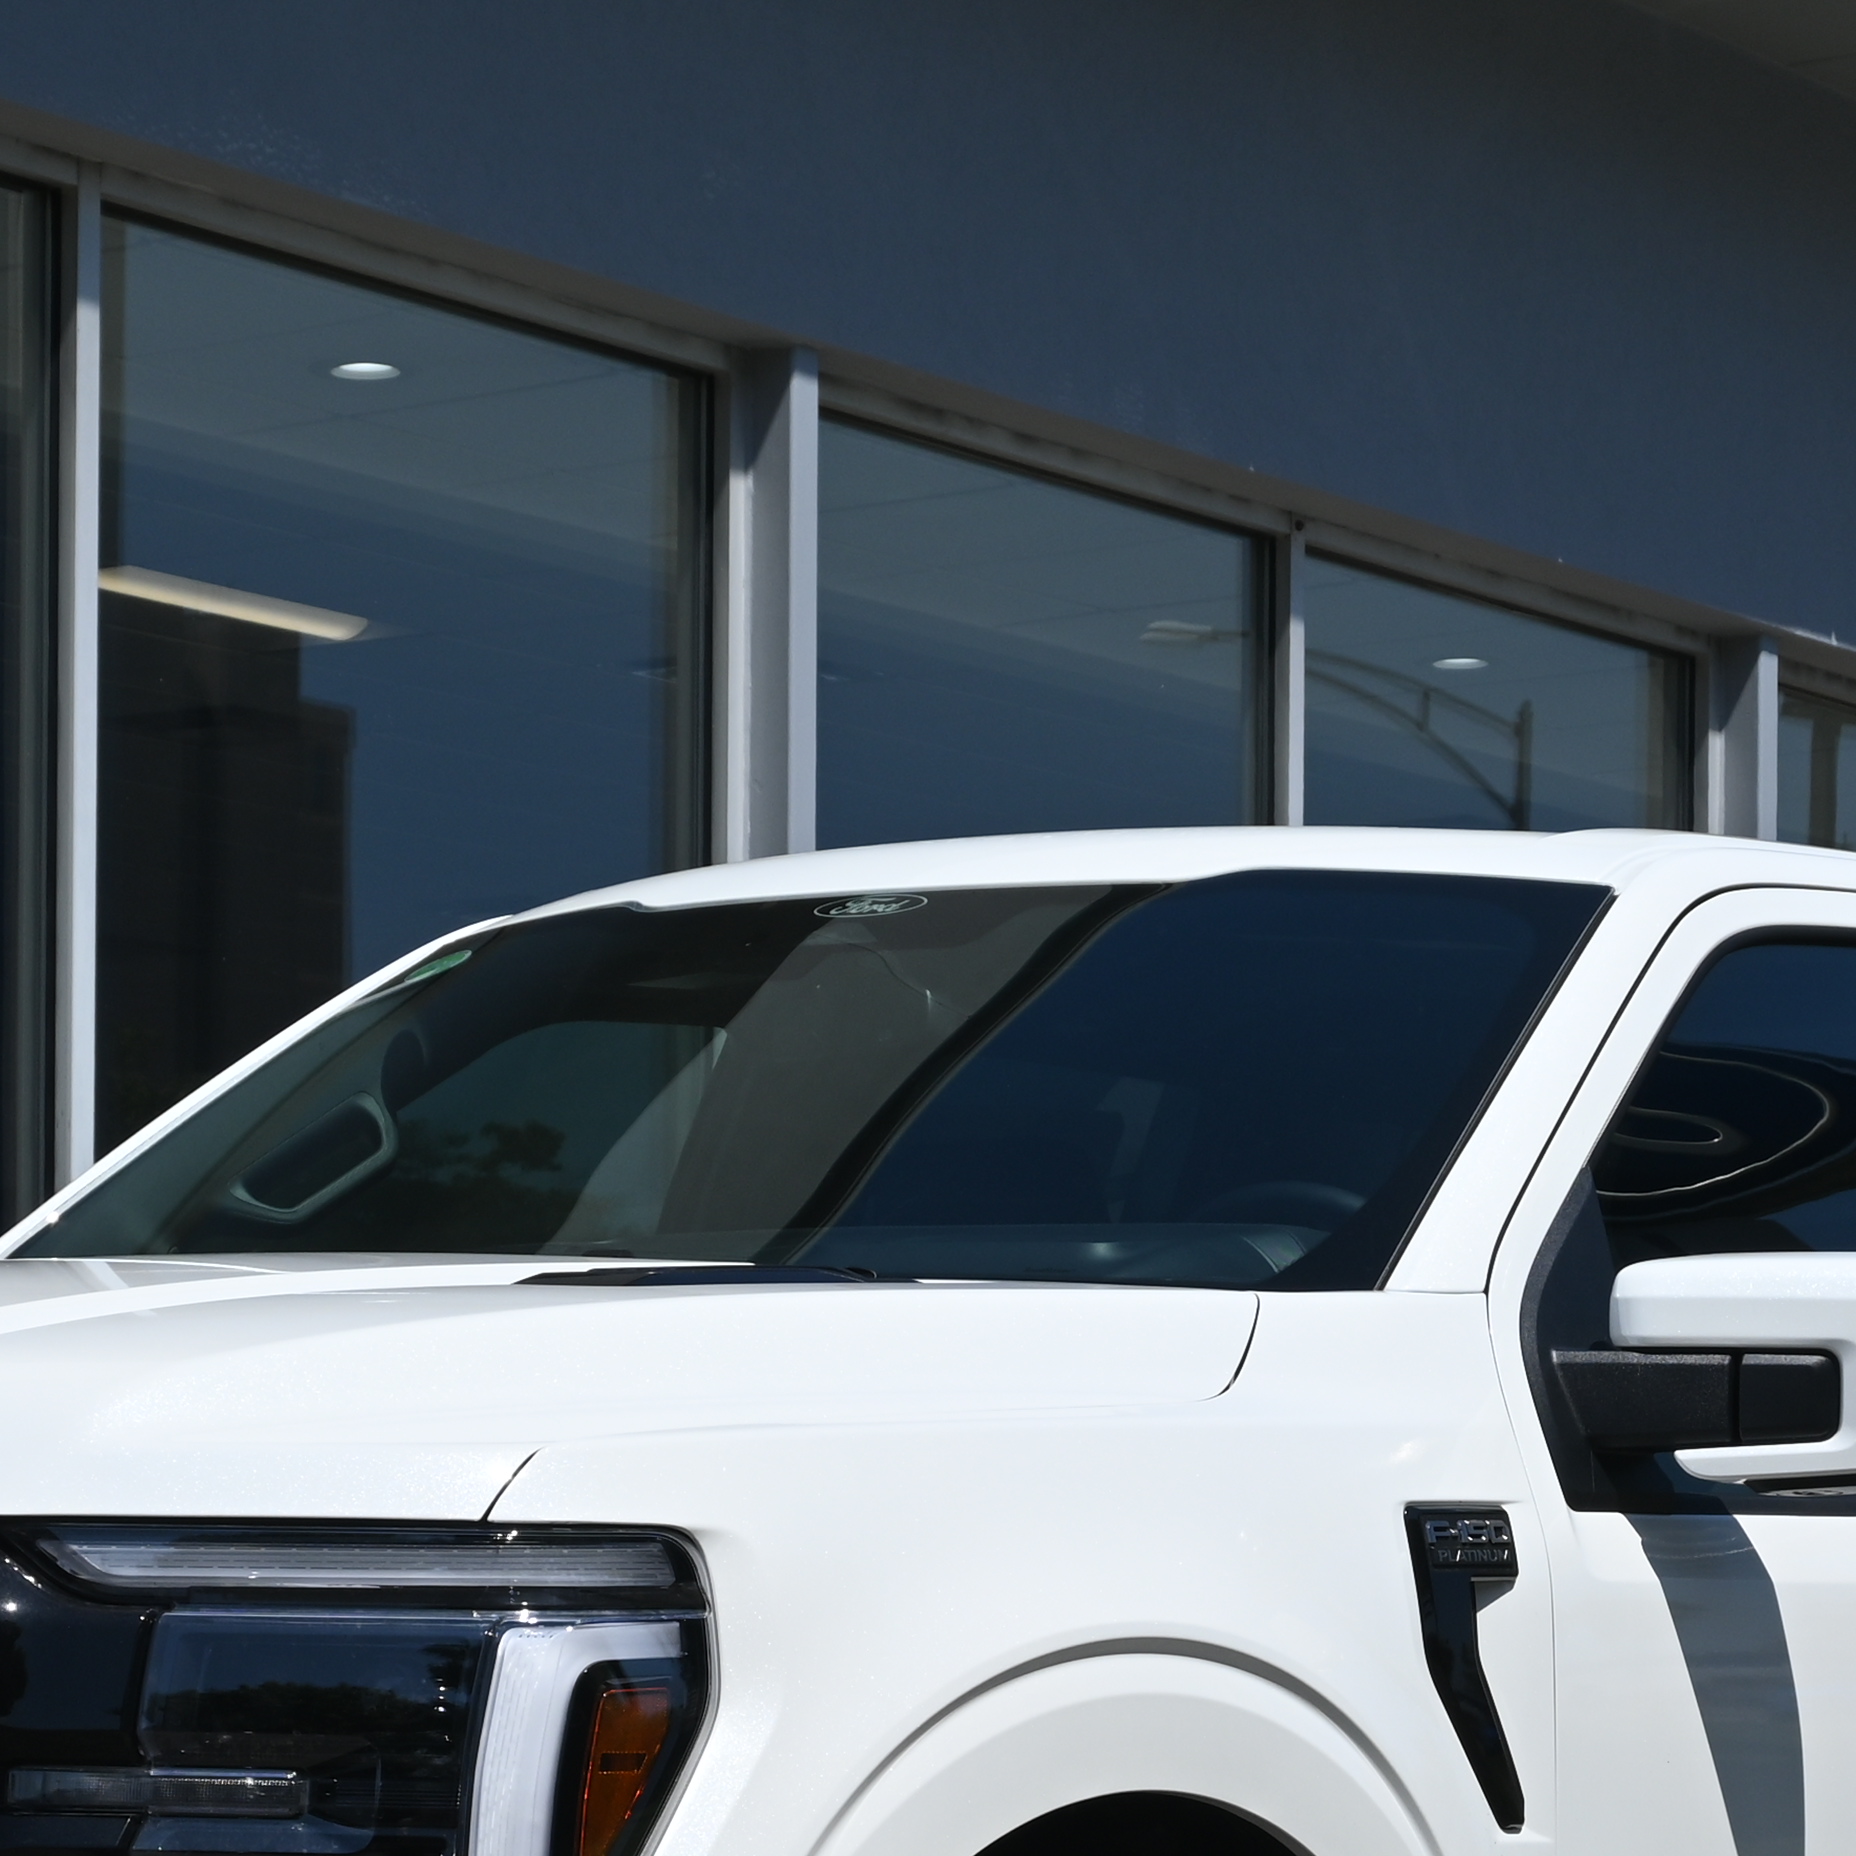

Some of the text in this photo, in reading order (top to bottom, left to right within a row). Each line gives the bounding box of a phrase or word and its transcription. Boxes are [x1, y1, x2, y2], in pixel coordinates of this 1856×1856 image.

[828, 896, 911, 915] Ford
[1425, 1519, 1511, 1544] F-150
[1437, 1548, 1512, 1563] PLATINUM
